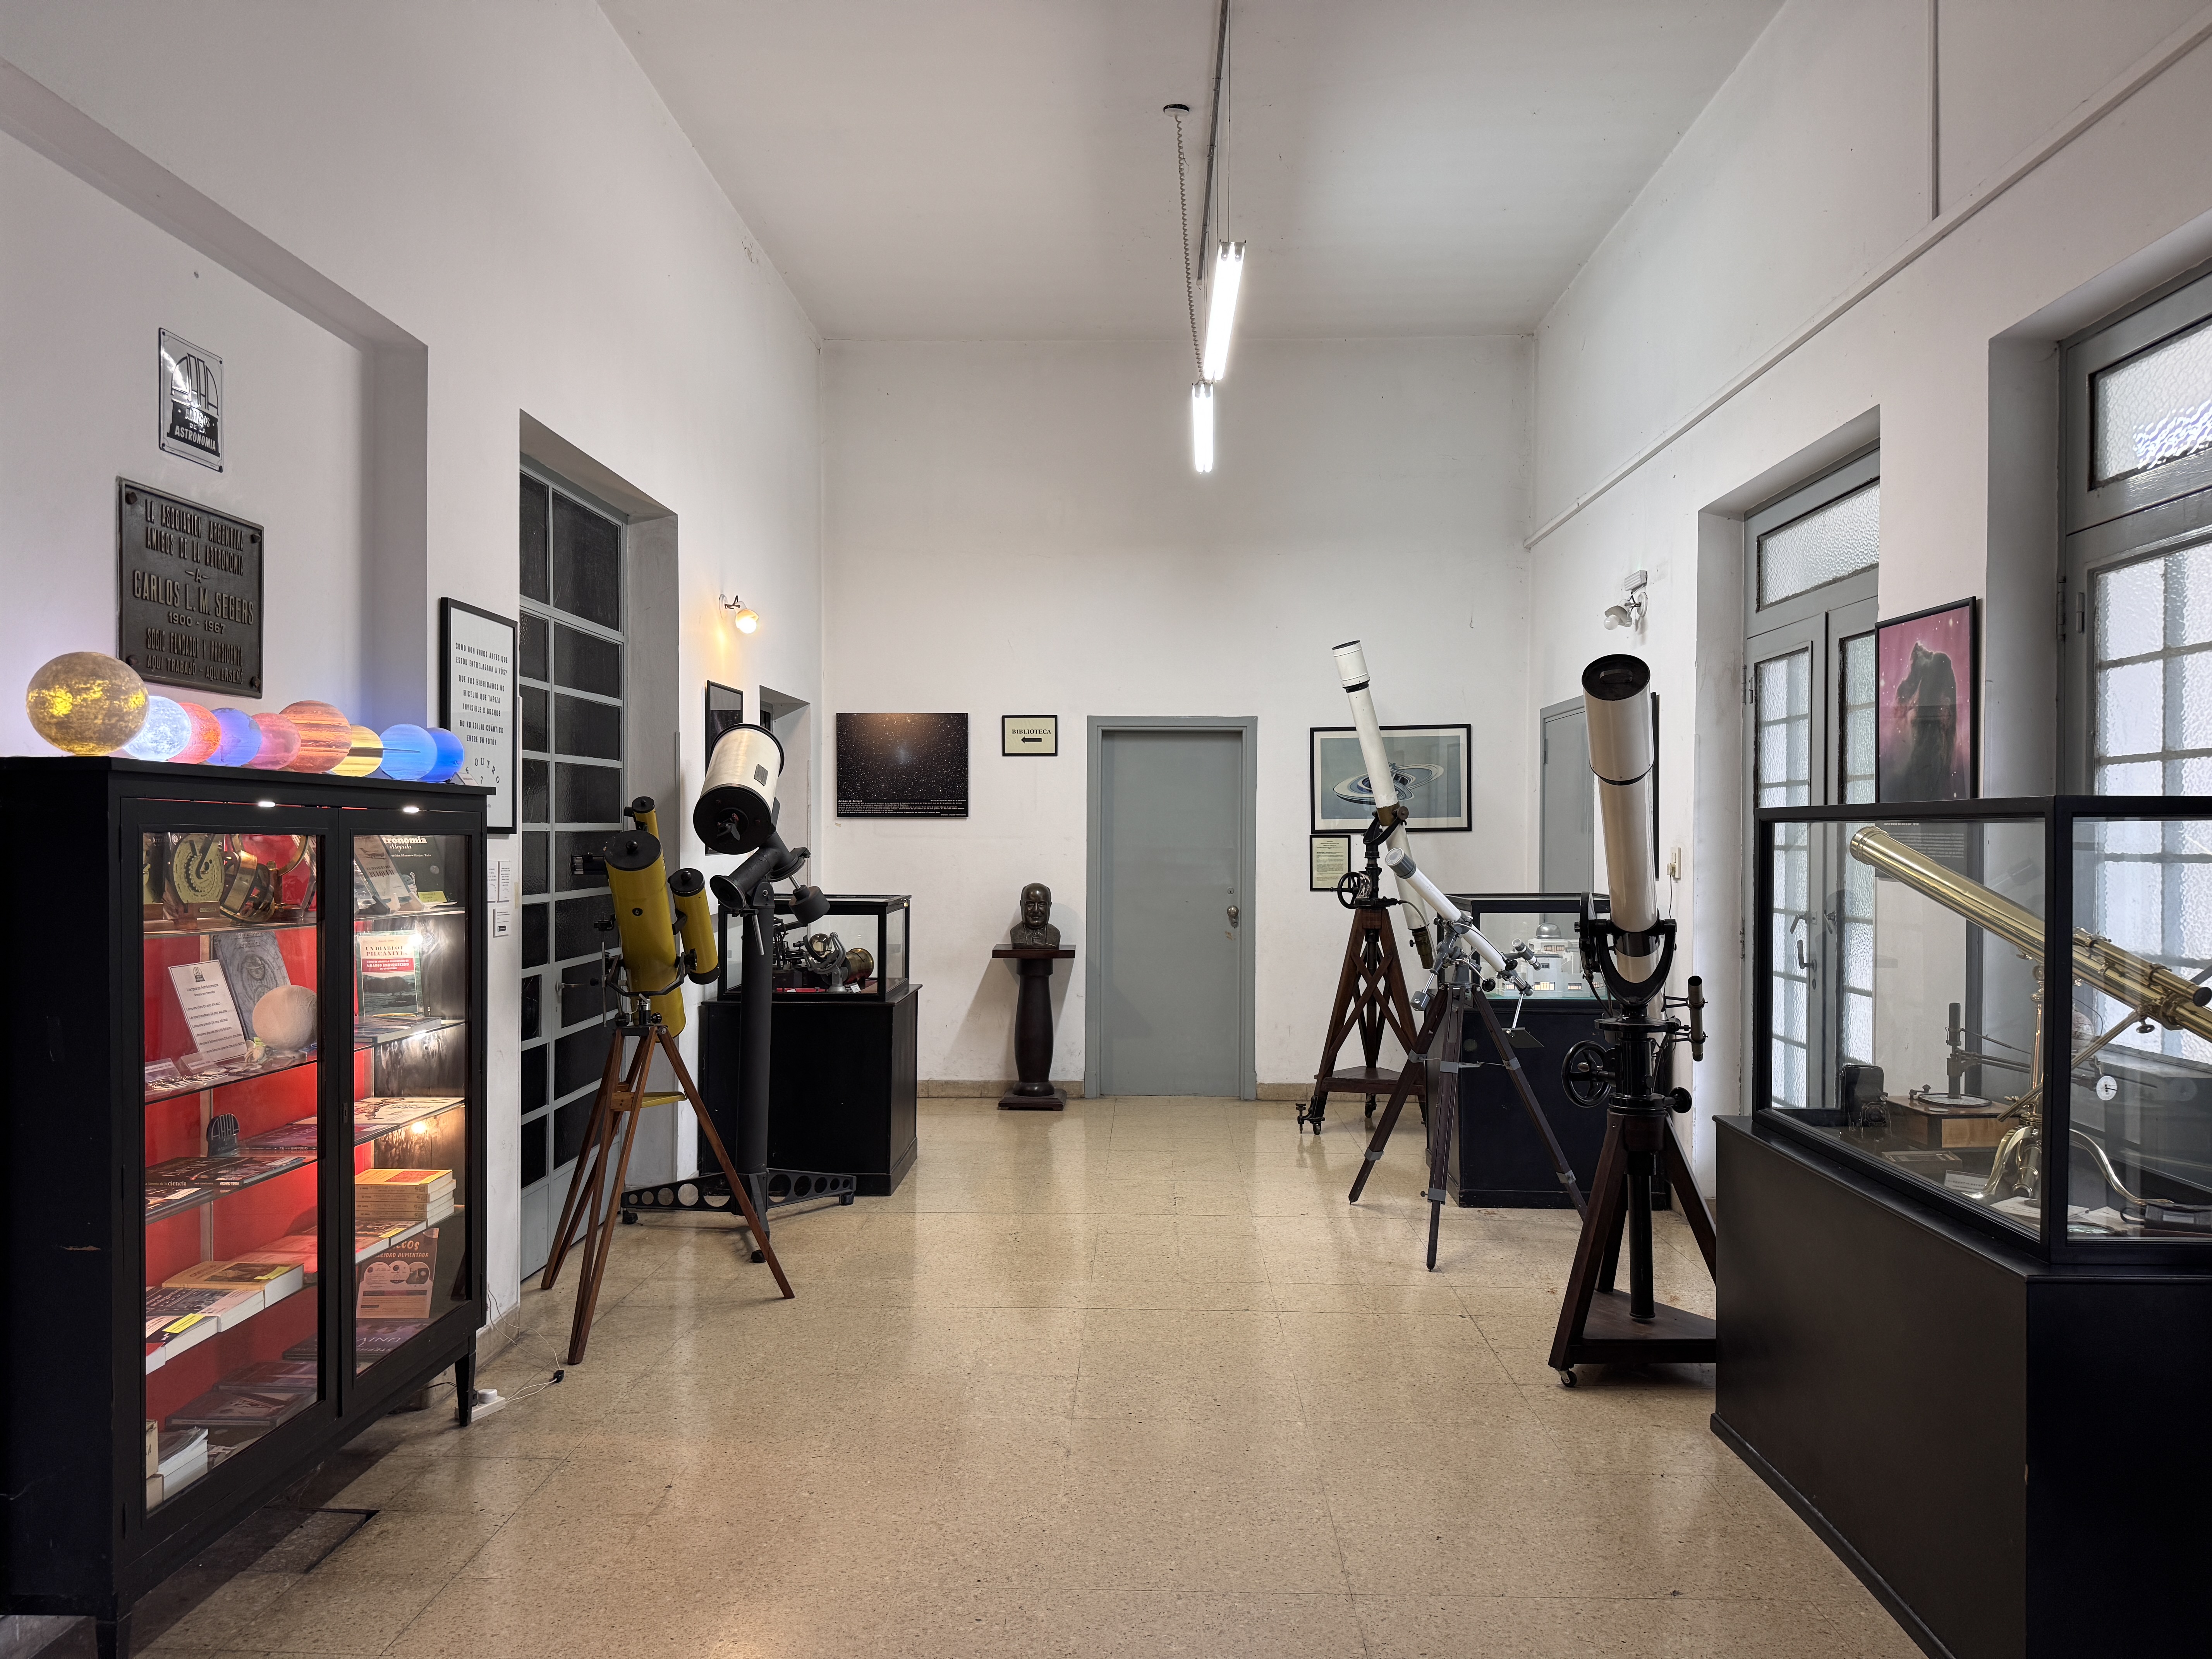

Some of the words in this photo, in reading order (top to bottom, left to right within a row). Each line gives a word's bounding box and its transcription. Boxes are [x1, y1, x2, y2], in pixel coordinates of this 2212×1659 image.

[185, 408, 210, 428] AMIGOS
[174, 425, 216, 451] ASTRONOMIA
[145, 499, 154, 523] LA
[161, 504, 201, 538] ASOCIACION
[209, 521, 243, 551] ARGENTINA
[146, 527, 173, 555] AMIGOS
[179, 537, 187, 559] DE
[193, 540, 200, 563] LA
[205, 545, 243, 576] ASTRONOMIA
[134, 570, 180, 607] CARLOS
[185, 584, 196, 611] L.
[199, 587, 211, 615] M.
[215, 592, 253, 625] SEGERS
[168, 611, 192, 627] 1900
[205, 620, 226, 634] 1967
[147, 628, 165, 652] SOCIO
[170, 632, 199, 658] FUNDADOR
[203, 639, 206, 660] Y
[211, 641, 242, 666] PRESIDENTE
[455, 642, 466, 651] COMO
[476, 649, 488, 658] VIMOS
[489, 652, 500, 661] ANTES
[147, 654, 163, 672] AQUI
[167, 658, 196, 675] TRABAJÓ
[206, 665, 218, 681] AQUI
[456, 656, 467, 665] ESTOU
[469, 660, 493, 672] ENTRELAZADA
[463, 690, 478, 699] MICELIO
[488, 695, 500, 704] TAPIZA
[463, 703, 481, 713] INVISIBLE
[487, 708, 501, 716] BOSQUE
[473, 722, 484, 730] IDILIO
[486, 724, 503, 734] CUÁNTICO
[467, 735, 478, 743] ENTRE
[486, 737, 496, 745] FOTÓN
[382, 836, 427, 844] tronomía
[390, 843, 412, 852] dibujada
